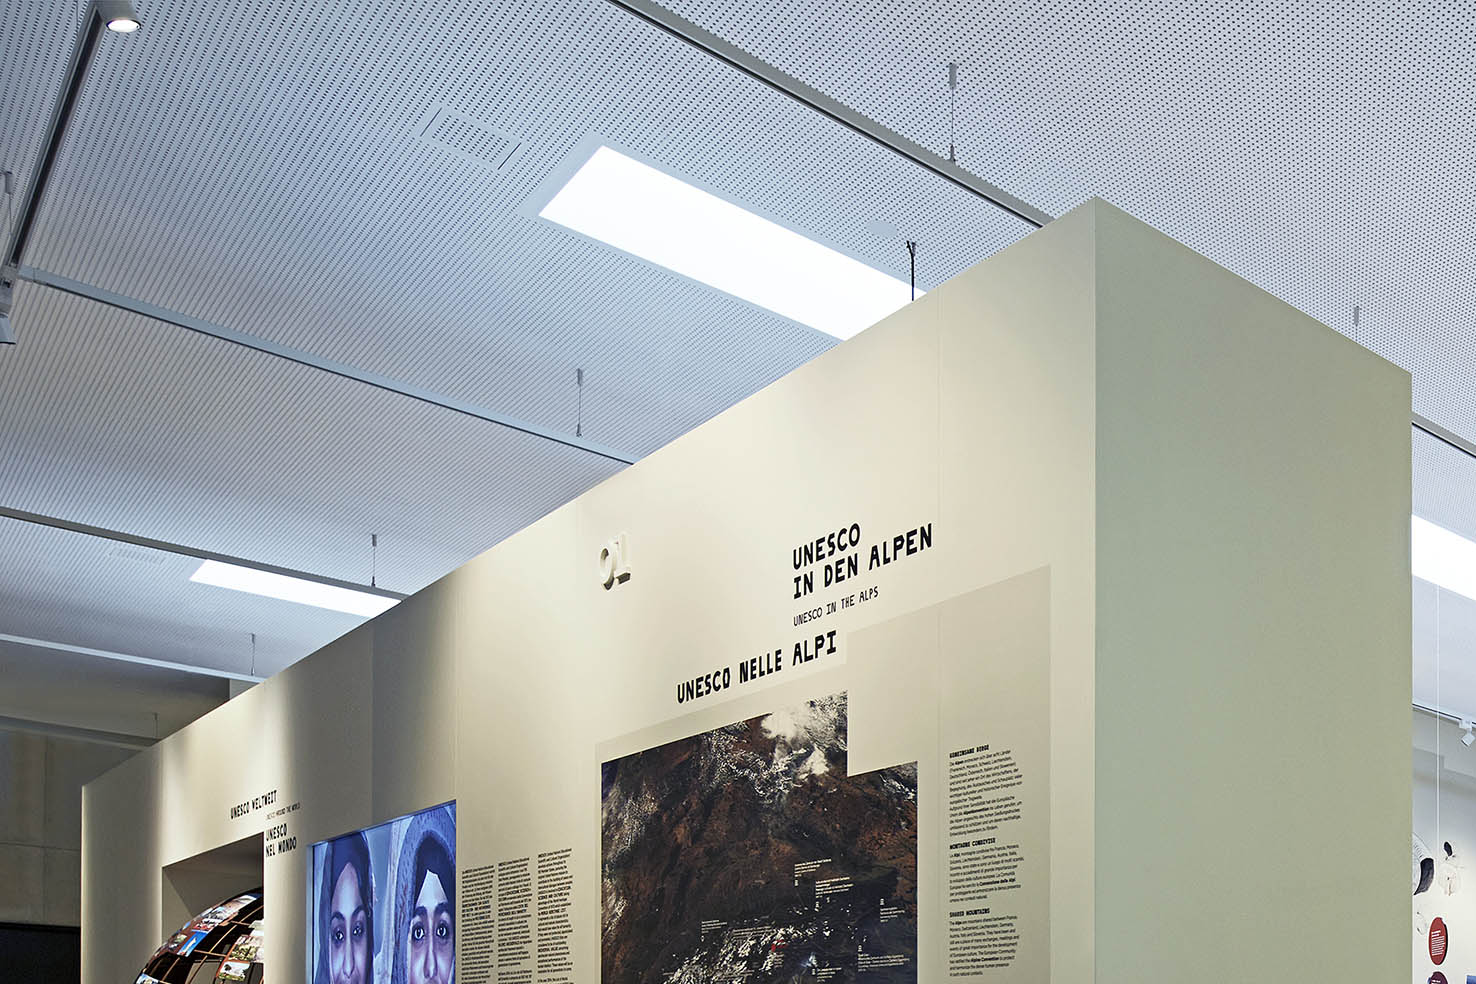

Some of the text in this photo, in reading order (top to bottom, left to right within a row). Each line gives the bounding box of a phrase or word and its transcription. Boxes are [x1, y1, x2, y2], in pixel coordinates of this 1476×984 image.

[793, 522, 860, 570] UNESCO
[793, 523, 932, 599] IN DEN ALPEN
[794, 586, 879, 626] UNESCO IN THE ALPS
[677, 630, 837, 703] UNESCO NELLE ALPI
[231, 801, 249, 819] UNESCO
[266, 823, 287, 841] UNESCO
[266, 836, 297, 857] NEL MONDO
